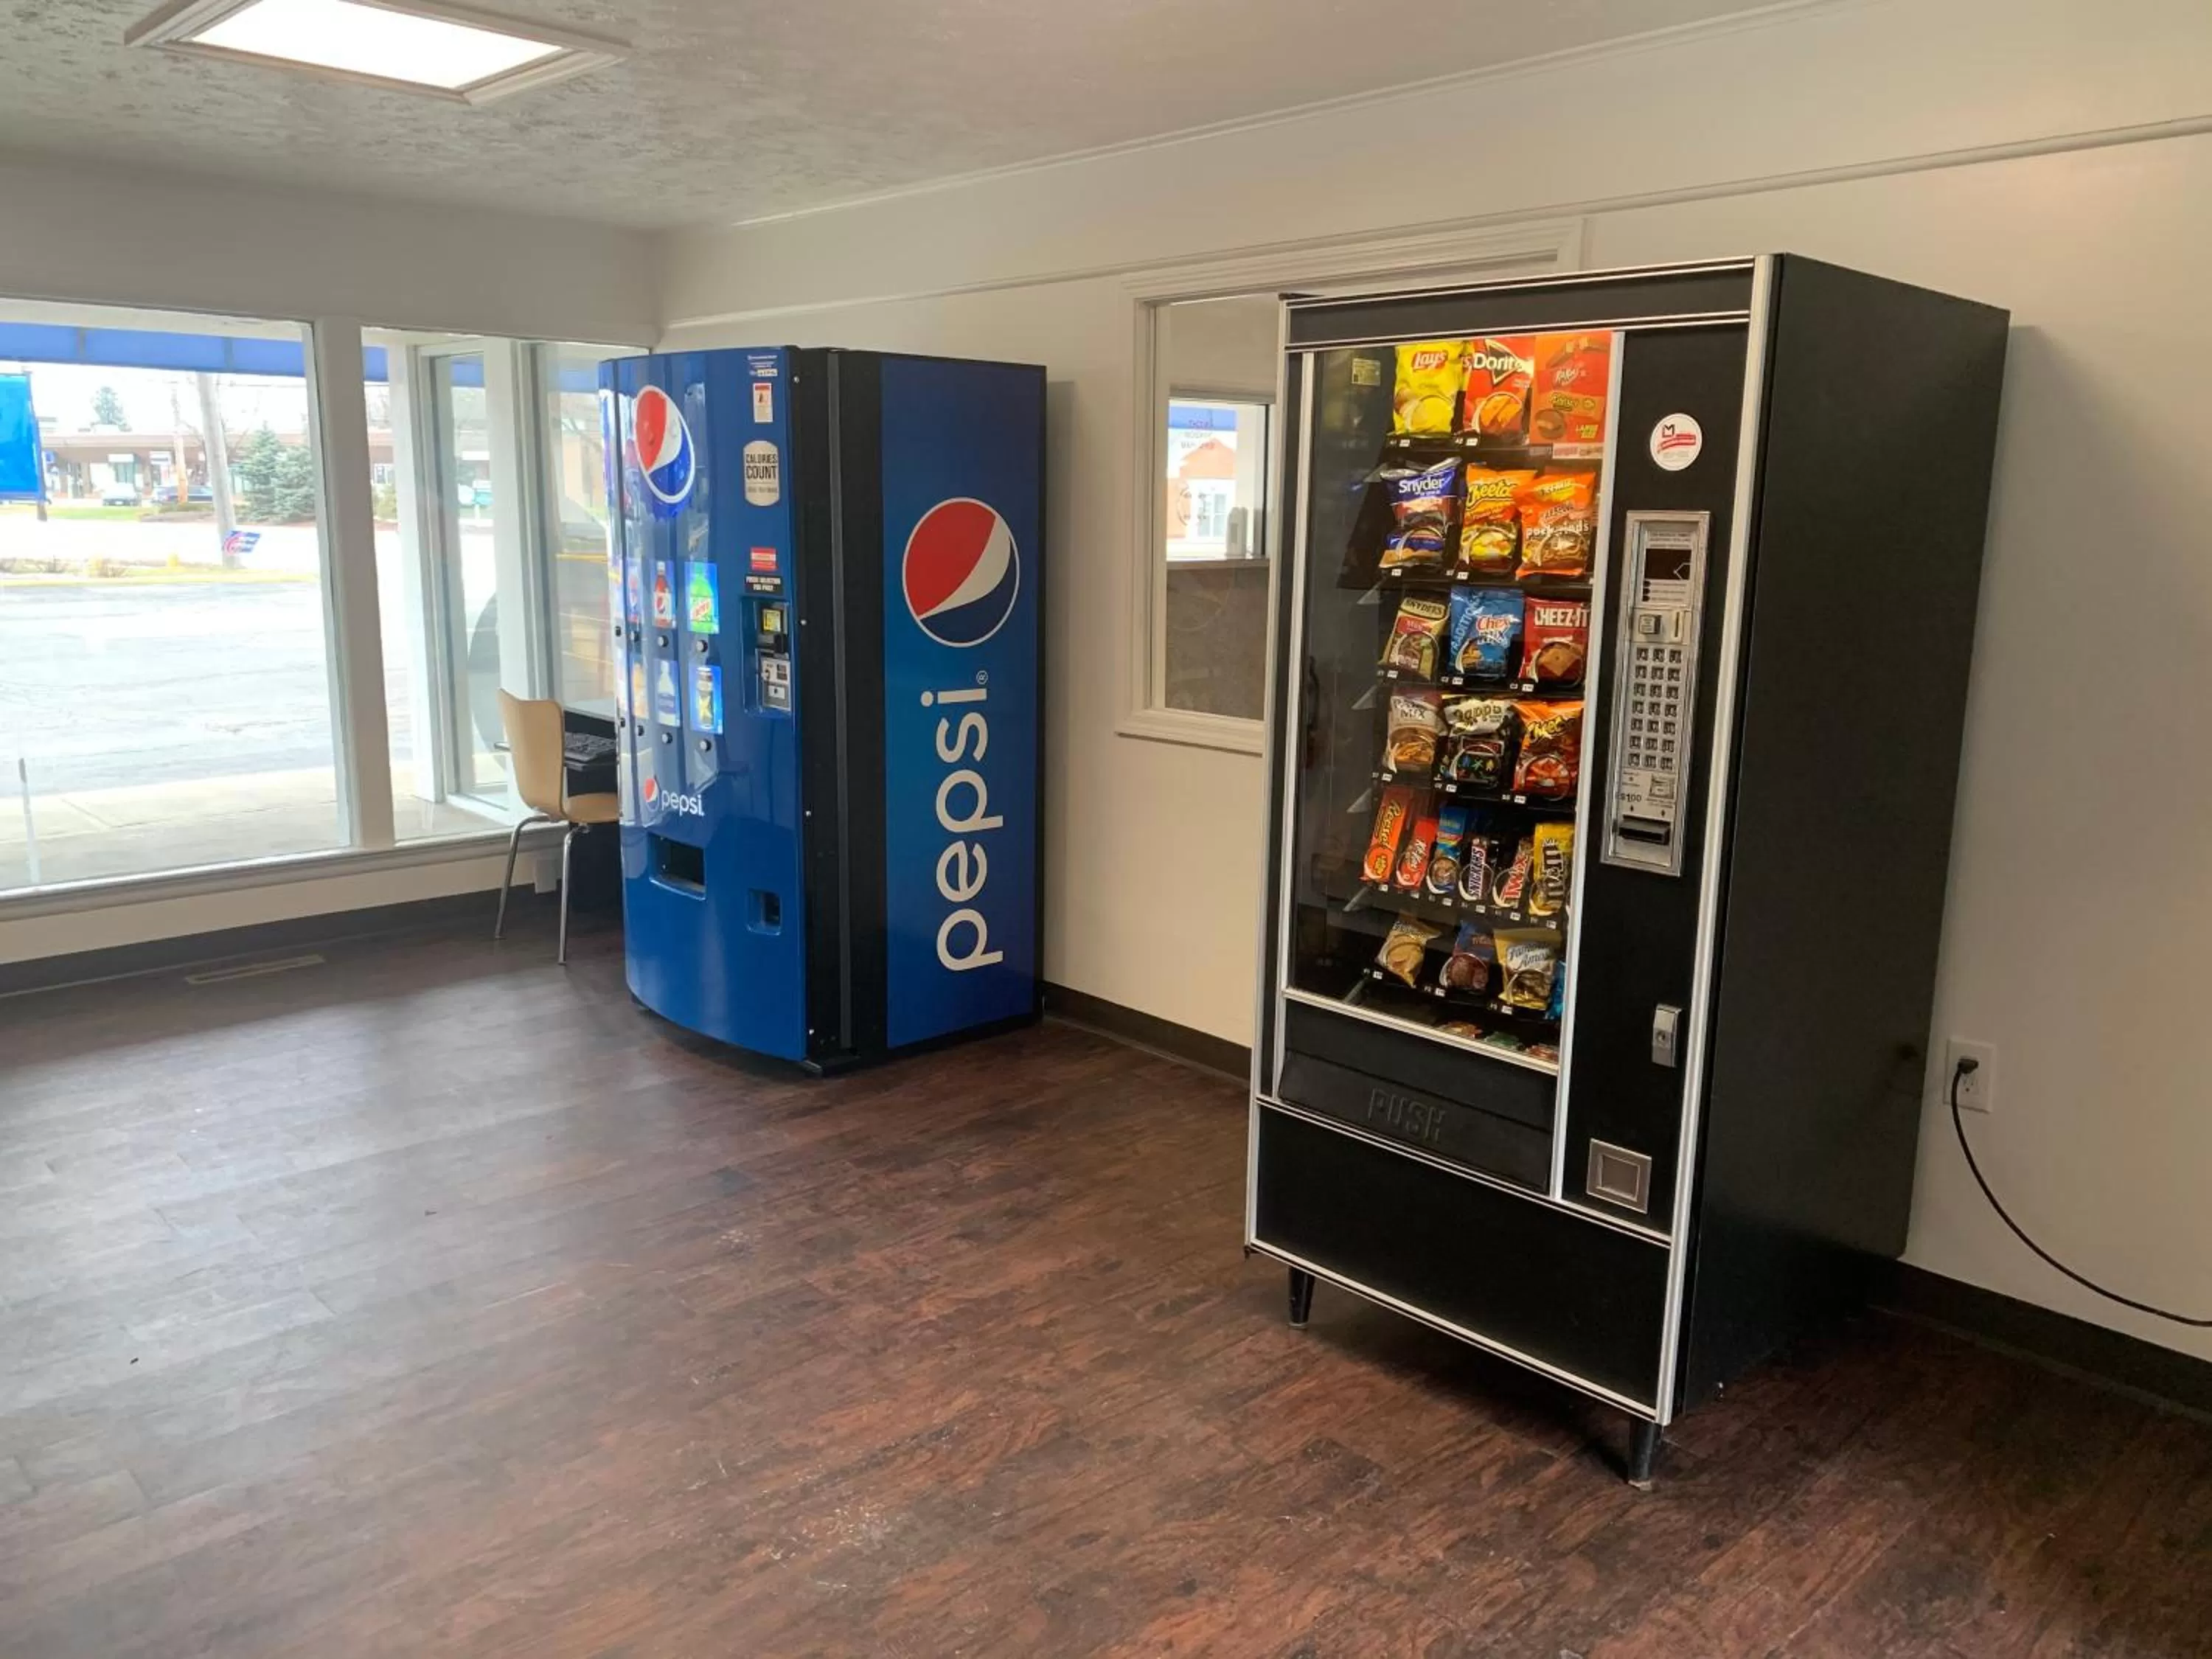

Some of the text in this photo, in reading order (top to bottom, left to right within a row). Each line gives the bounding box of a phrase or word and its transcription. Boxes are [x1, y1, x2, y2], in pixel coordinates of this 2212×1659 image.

[746, 465, 777, 480] COUNT
[1534, 607, 1589, 627] CHEEZ-IT
[661, 790, 706, 817] pepsi
[920, 687, 1004, 972] pepsi
[1368, 1088, 1447, 1141] PUSH
